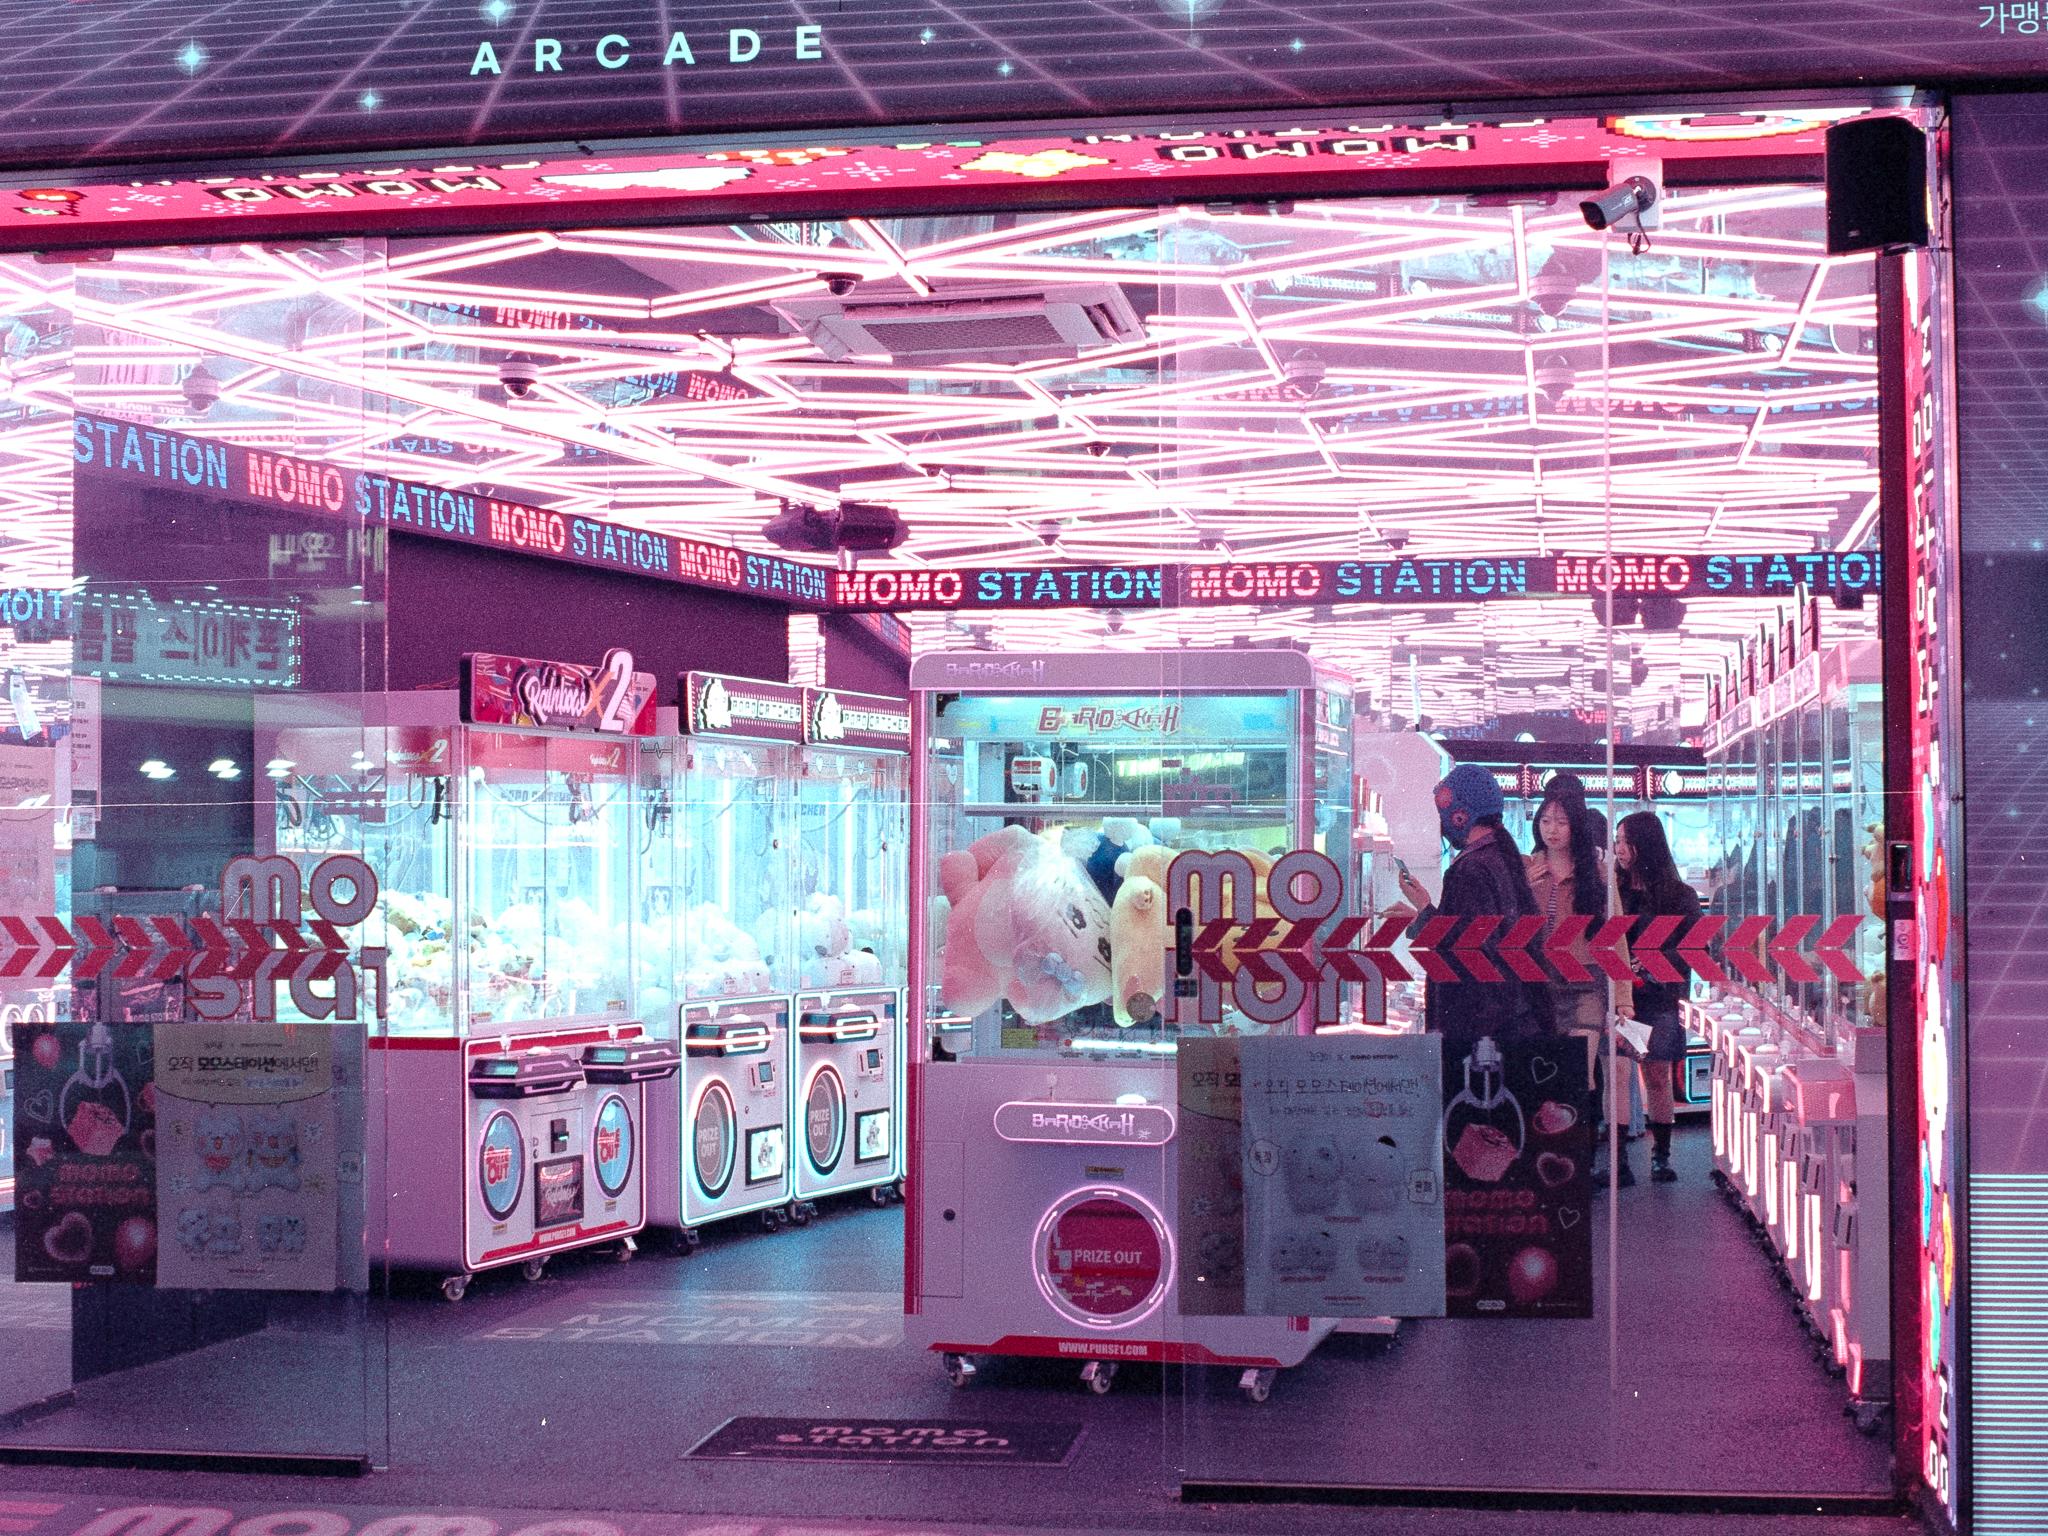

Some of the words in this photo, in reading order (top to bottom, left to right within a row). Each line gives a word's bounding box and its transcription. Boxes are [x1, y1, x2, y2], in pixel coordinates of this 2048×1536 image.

[1979, 1, 2048, 35] 가맹
[470, 24, 823, 76] ARCADE
[73, 416, 228, 490] STATION
[248, 452, 344, 512] MOMO
[355, 474, 475, 536] STATION
[490, 502, 566, 553] MOMO
[572, 519, 669, 573] STATION
[679, 541, 741, 588] MOMO
[746, 555, 827, 601] STATION
[836, 570, 963, 604] MOMO
[977, 567, 1162, 601] STATION
[1189, 563, 1322, 599] MOMO
[1336, 557, 1527, 597] STATION
[1556, 555, 1691, 594] MOMO
[220, 854, 379, 927] mo
[1167, 849, 1343, 927] mo
[809, 1108, 830, 1121] PRIZE
[699, 1126, 719, 1141] PRIZE
[812, 1123, 828, 1136] OUT
[702, 1143, 717, 1157] OUT
[487, 1160, 510, 1185] OUT
[1074, 1250, 1111, 1264] PRIZE
[1114, 1251, 1142, 1265] OUT
[809, 1426, 989, 1438] momo
